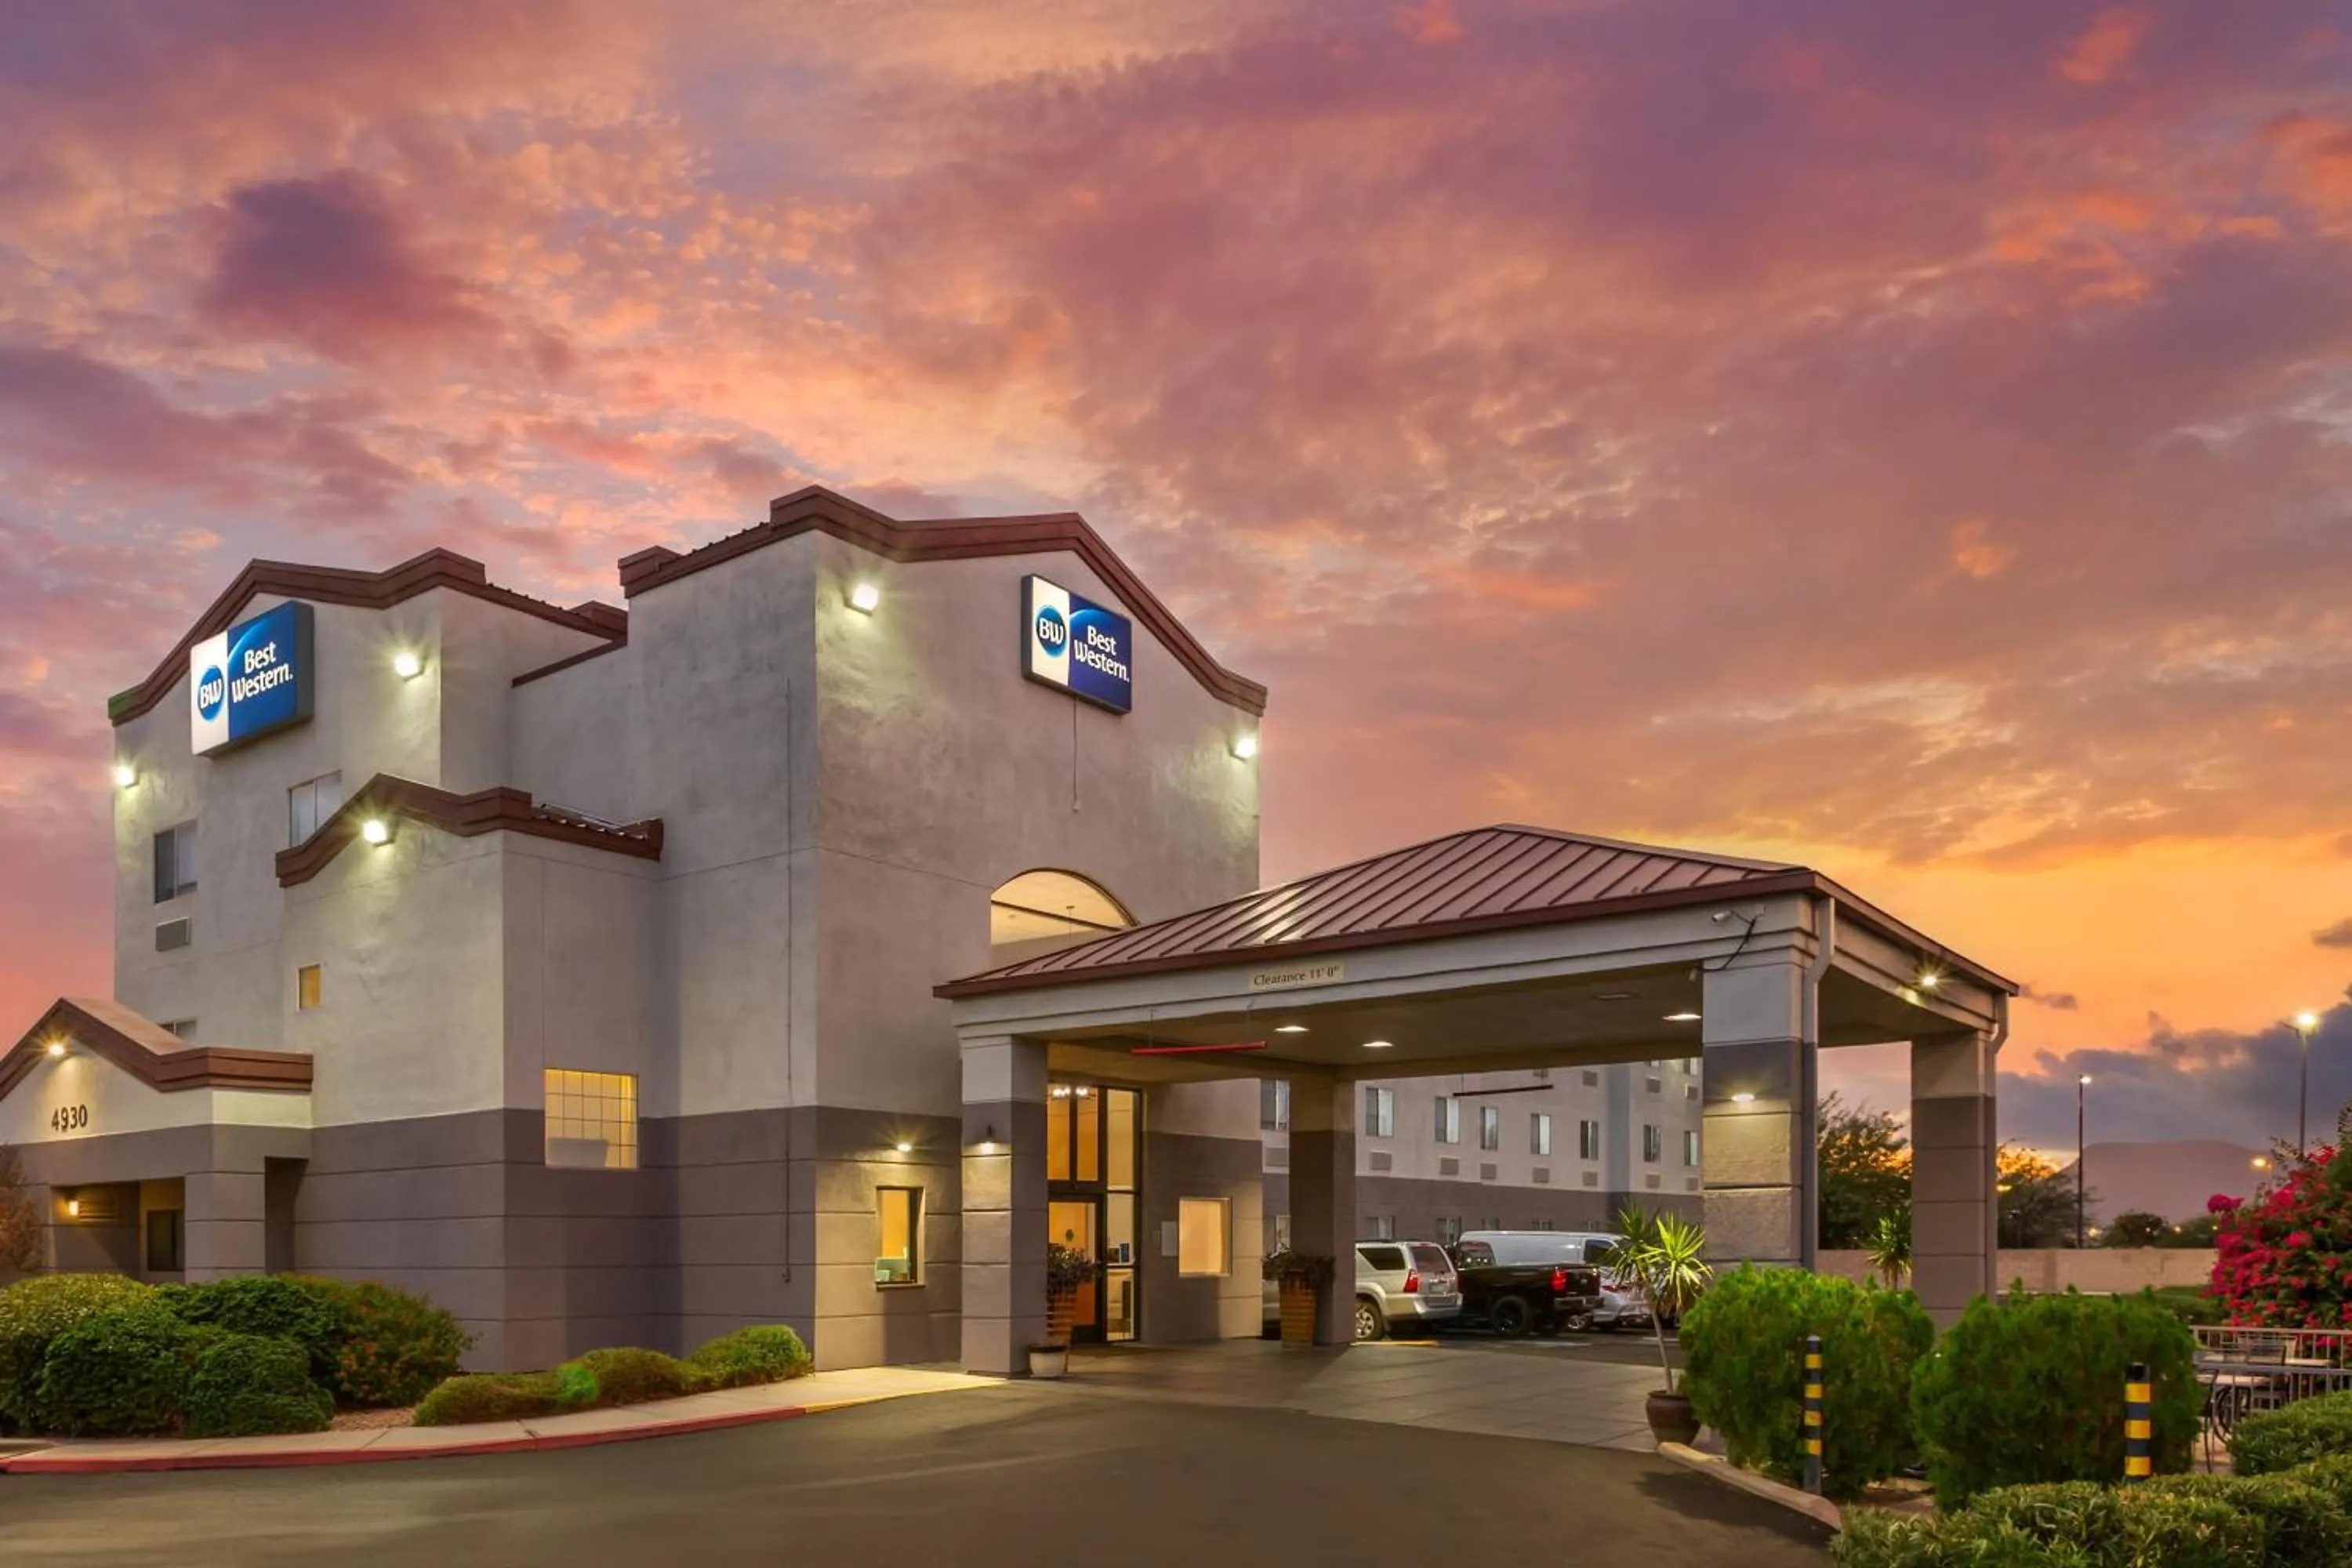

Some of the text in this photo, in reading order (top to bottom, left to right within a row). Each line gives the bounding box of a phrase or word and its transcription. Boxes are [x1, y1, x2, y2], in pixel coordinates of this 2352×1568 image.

[1039, 618, 1064, 644] BW
[1087, 625, 1116, 655] Best
[244, 641, 276, 674] Best
[200, 678, 222, 709] BW
[1254, 972, 1306, 986] Clearance
[51, 1103, 89, 1132] 4930
